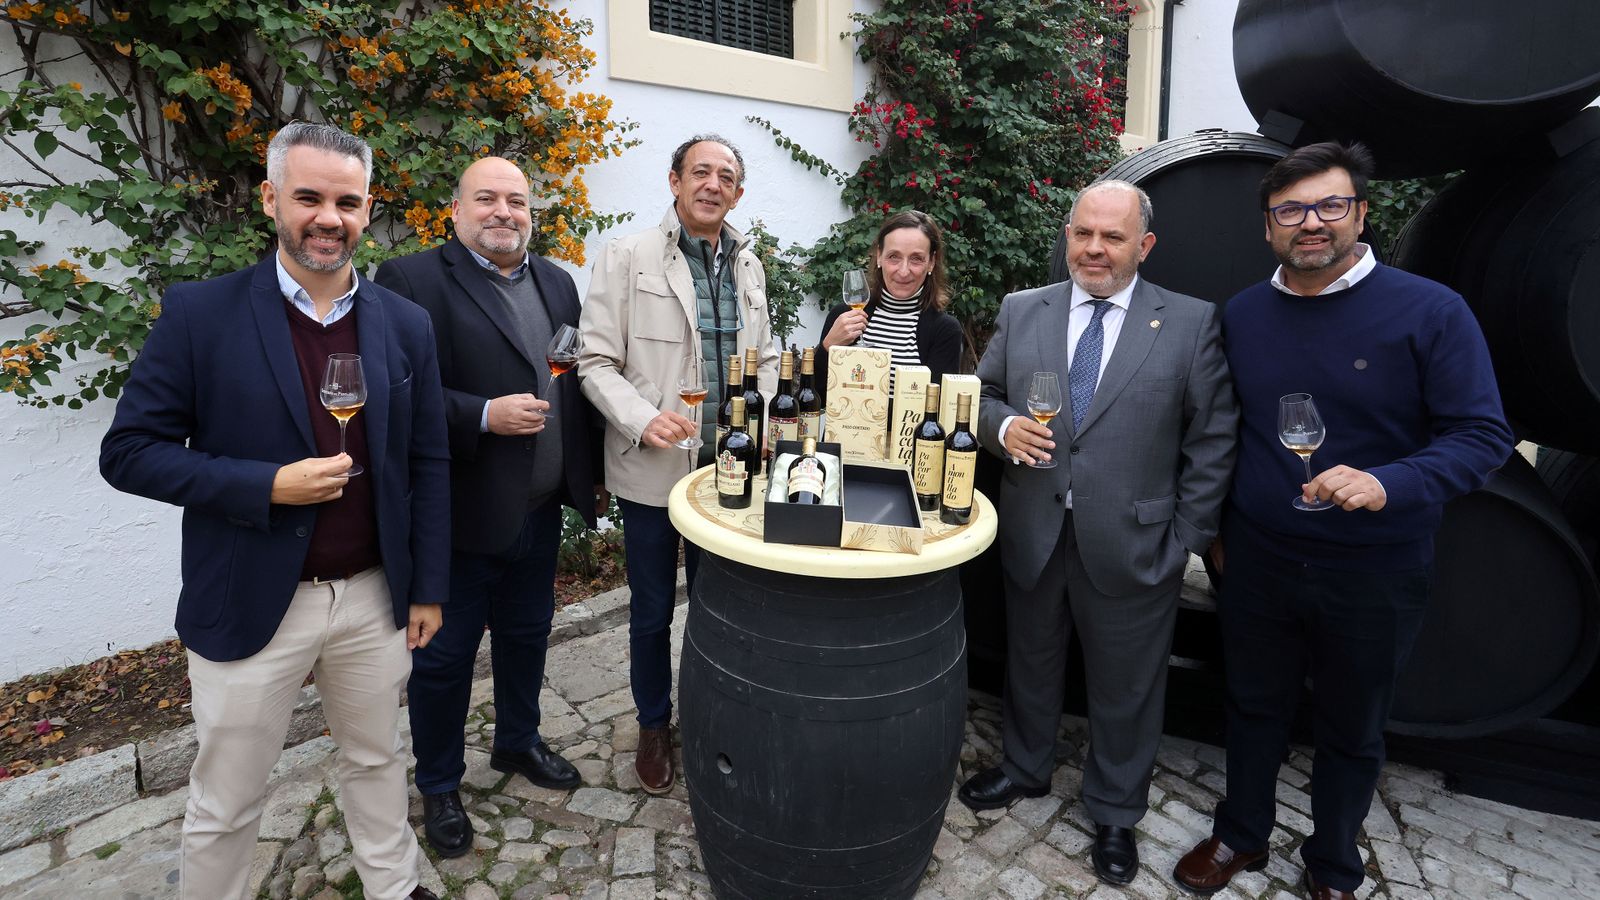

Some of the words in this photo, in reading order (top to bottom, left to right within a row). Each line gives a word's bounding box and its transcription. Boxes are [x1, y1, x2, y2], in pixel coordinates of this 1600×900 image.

[902, 410, 920, 423] Pa
[900, 423, 913, 436] lo
[899, 437, 913, 447] co
[898, 447, 912, 459] ta
[919, 452, 930, 460] Pa
[917, 459, 926, 467] lo
[917, 472, 925, 480] ta
[947, 476, 954, 484] ti
[916, 479, 927, 487] do
[946, 484, 958, 493] lla
